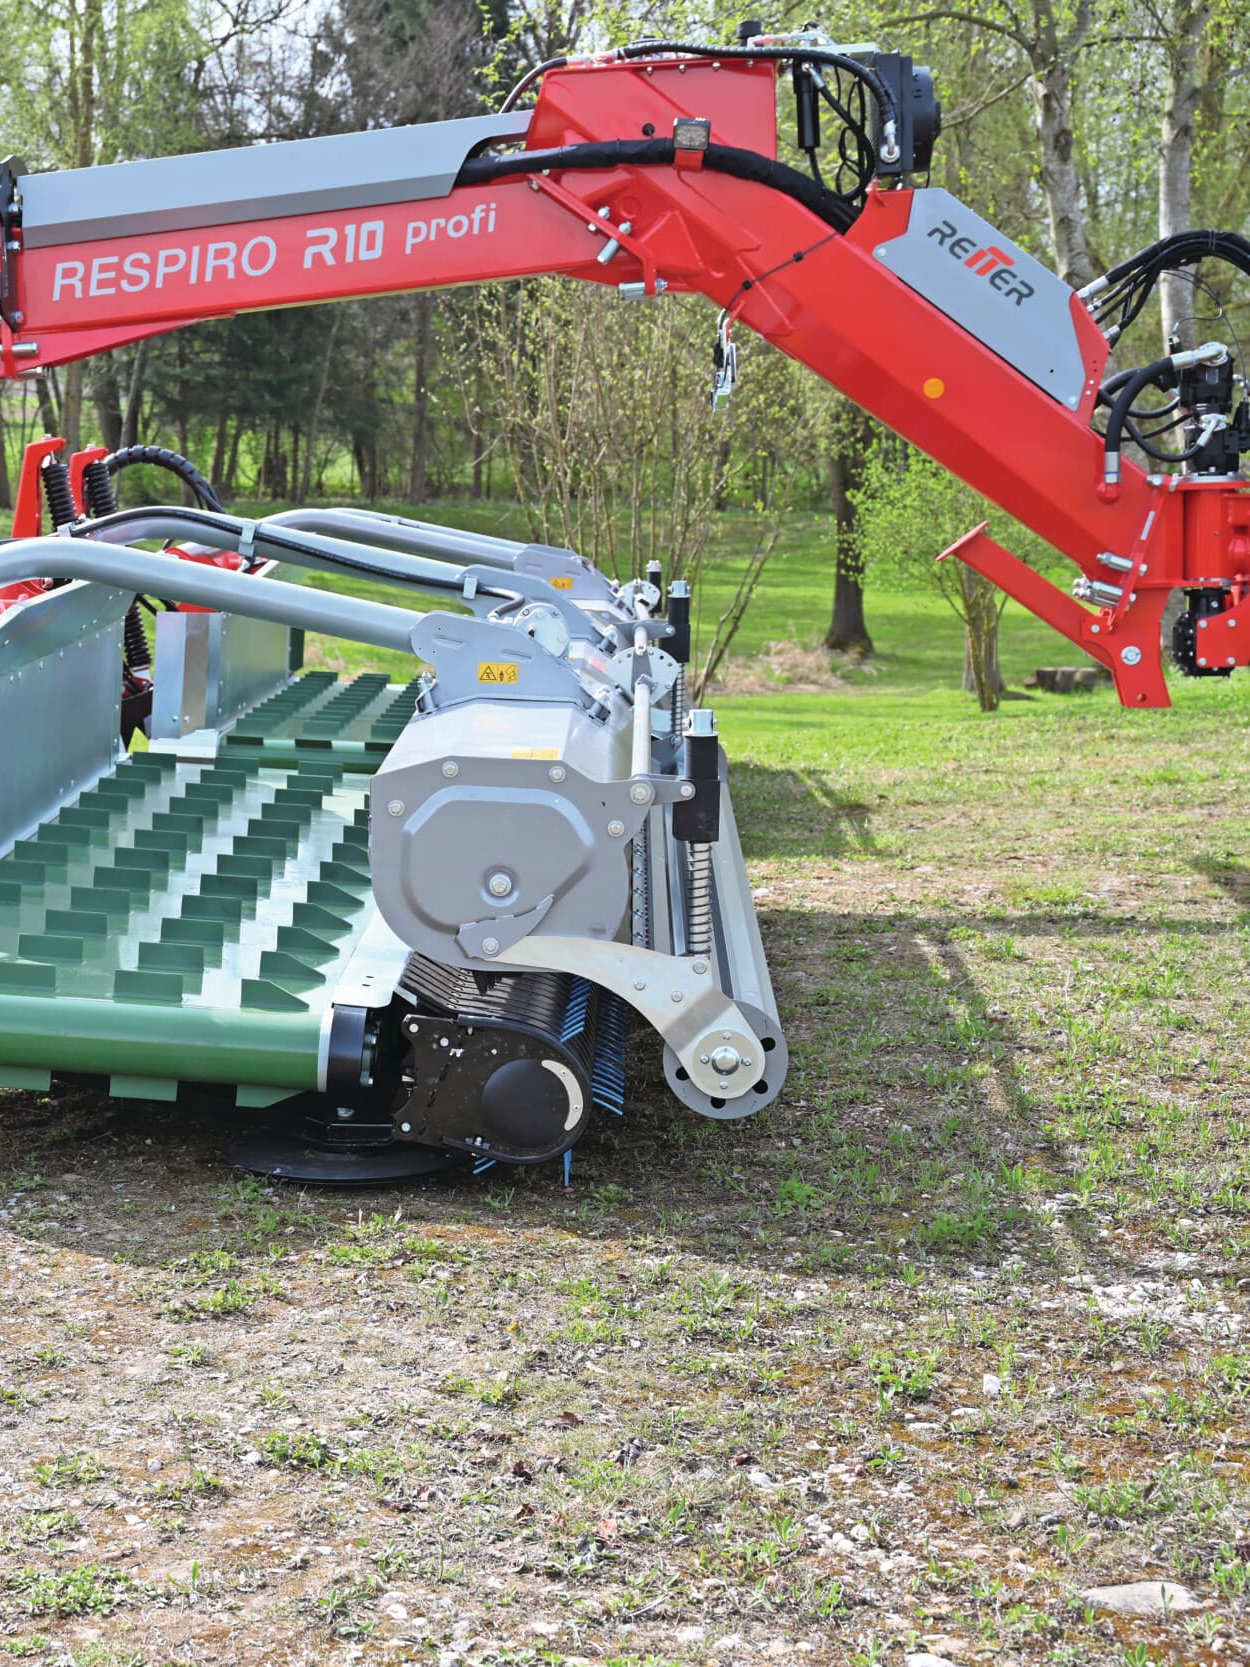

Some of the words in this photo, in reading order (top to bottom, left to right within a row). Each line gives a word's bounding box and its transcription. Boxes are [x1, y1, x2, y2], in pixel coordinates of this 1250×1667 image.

[53, 235, 276, 302] RESPIRO
[303, 220, 384, 269] R10
[405, 203, 497, 254] profi
[927, 220, 1034, 306] REITER
